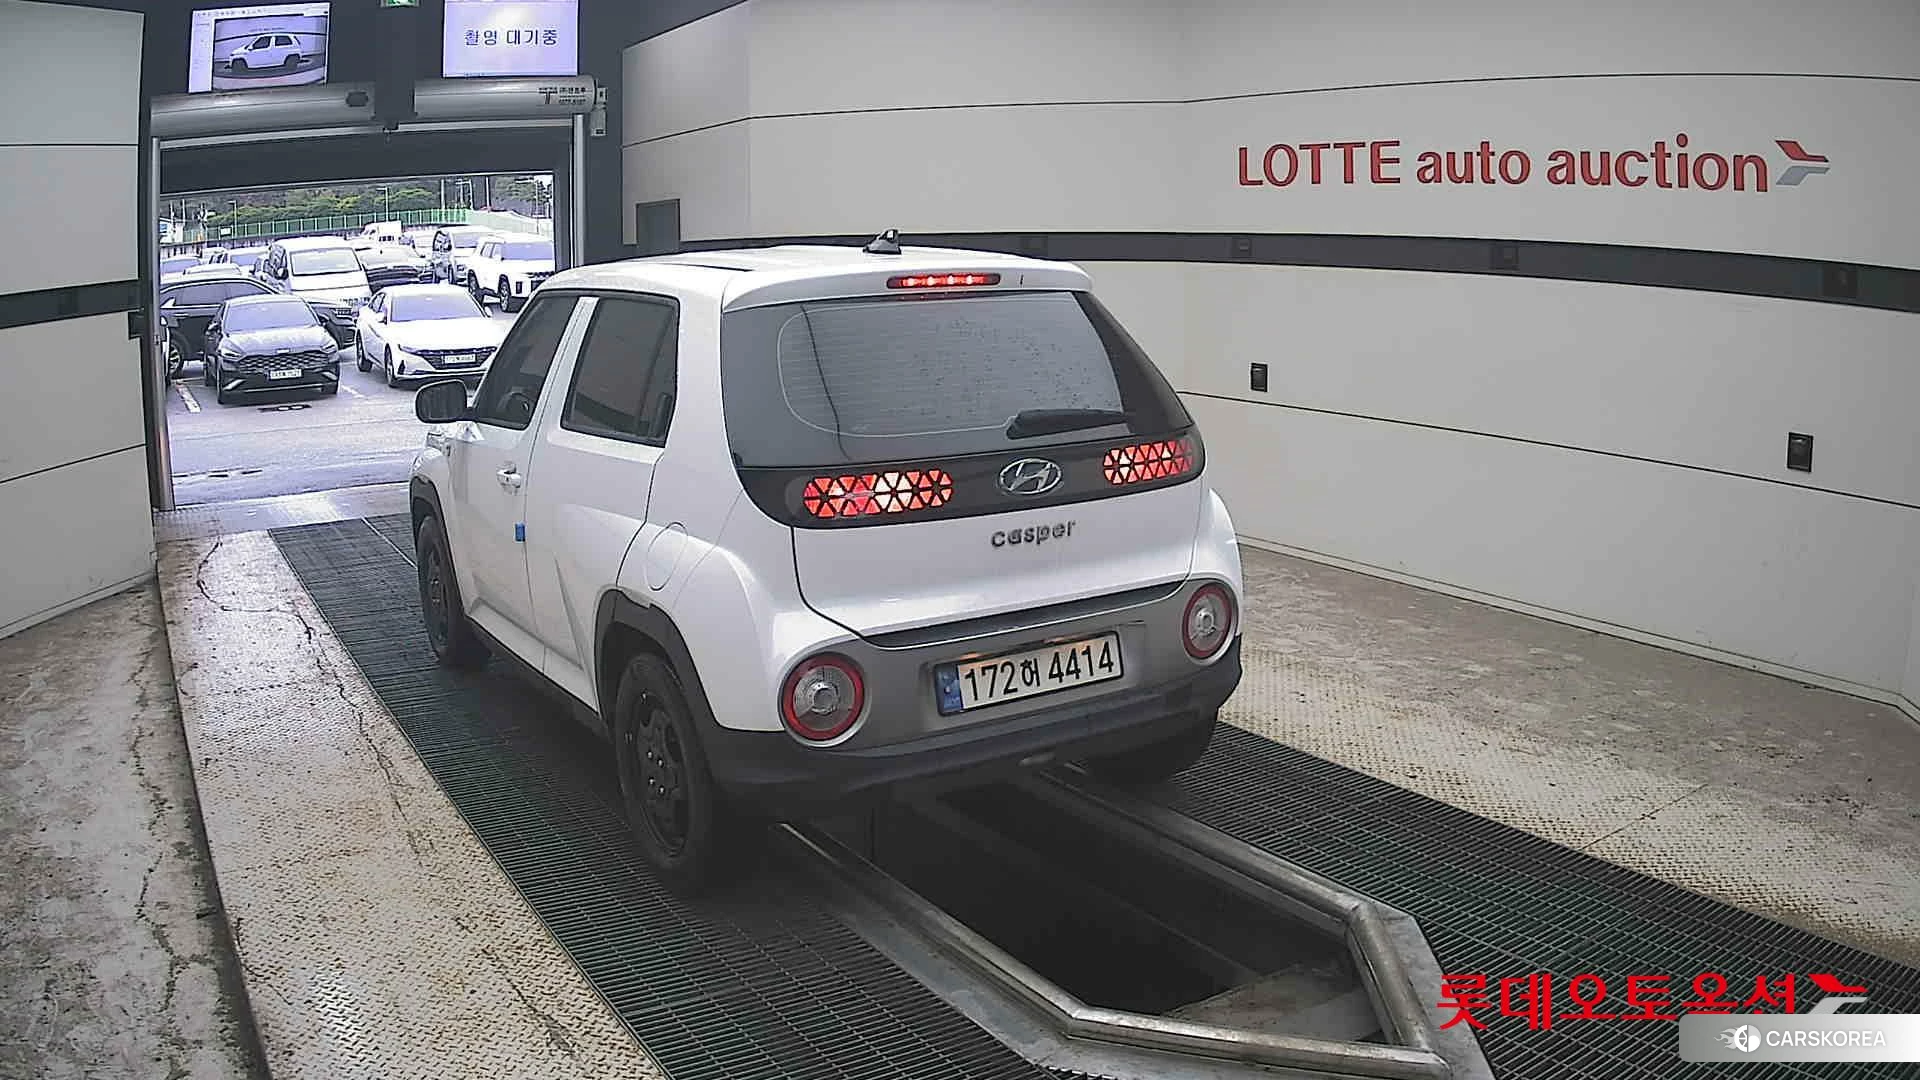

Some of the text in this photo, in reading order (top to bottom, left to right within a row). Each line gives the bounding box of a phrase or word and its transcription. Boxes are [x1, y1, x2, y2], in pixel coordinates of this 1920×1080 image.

[506, 29, 558, 46] 대기중
[1238, 133, 1769, 193] LOTTE auto auction
[991, 520, 1076, 547] casper
[964, 656, 1041, 702] 172허
[1048, 640, 1115, 684] 4414
